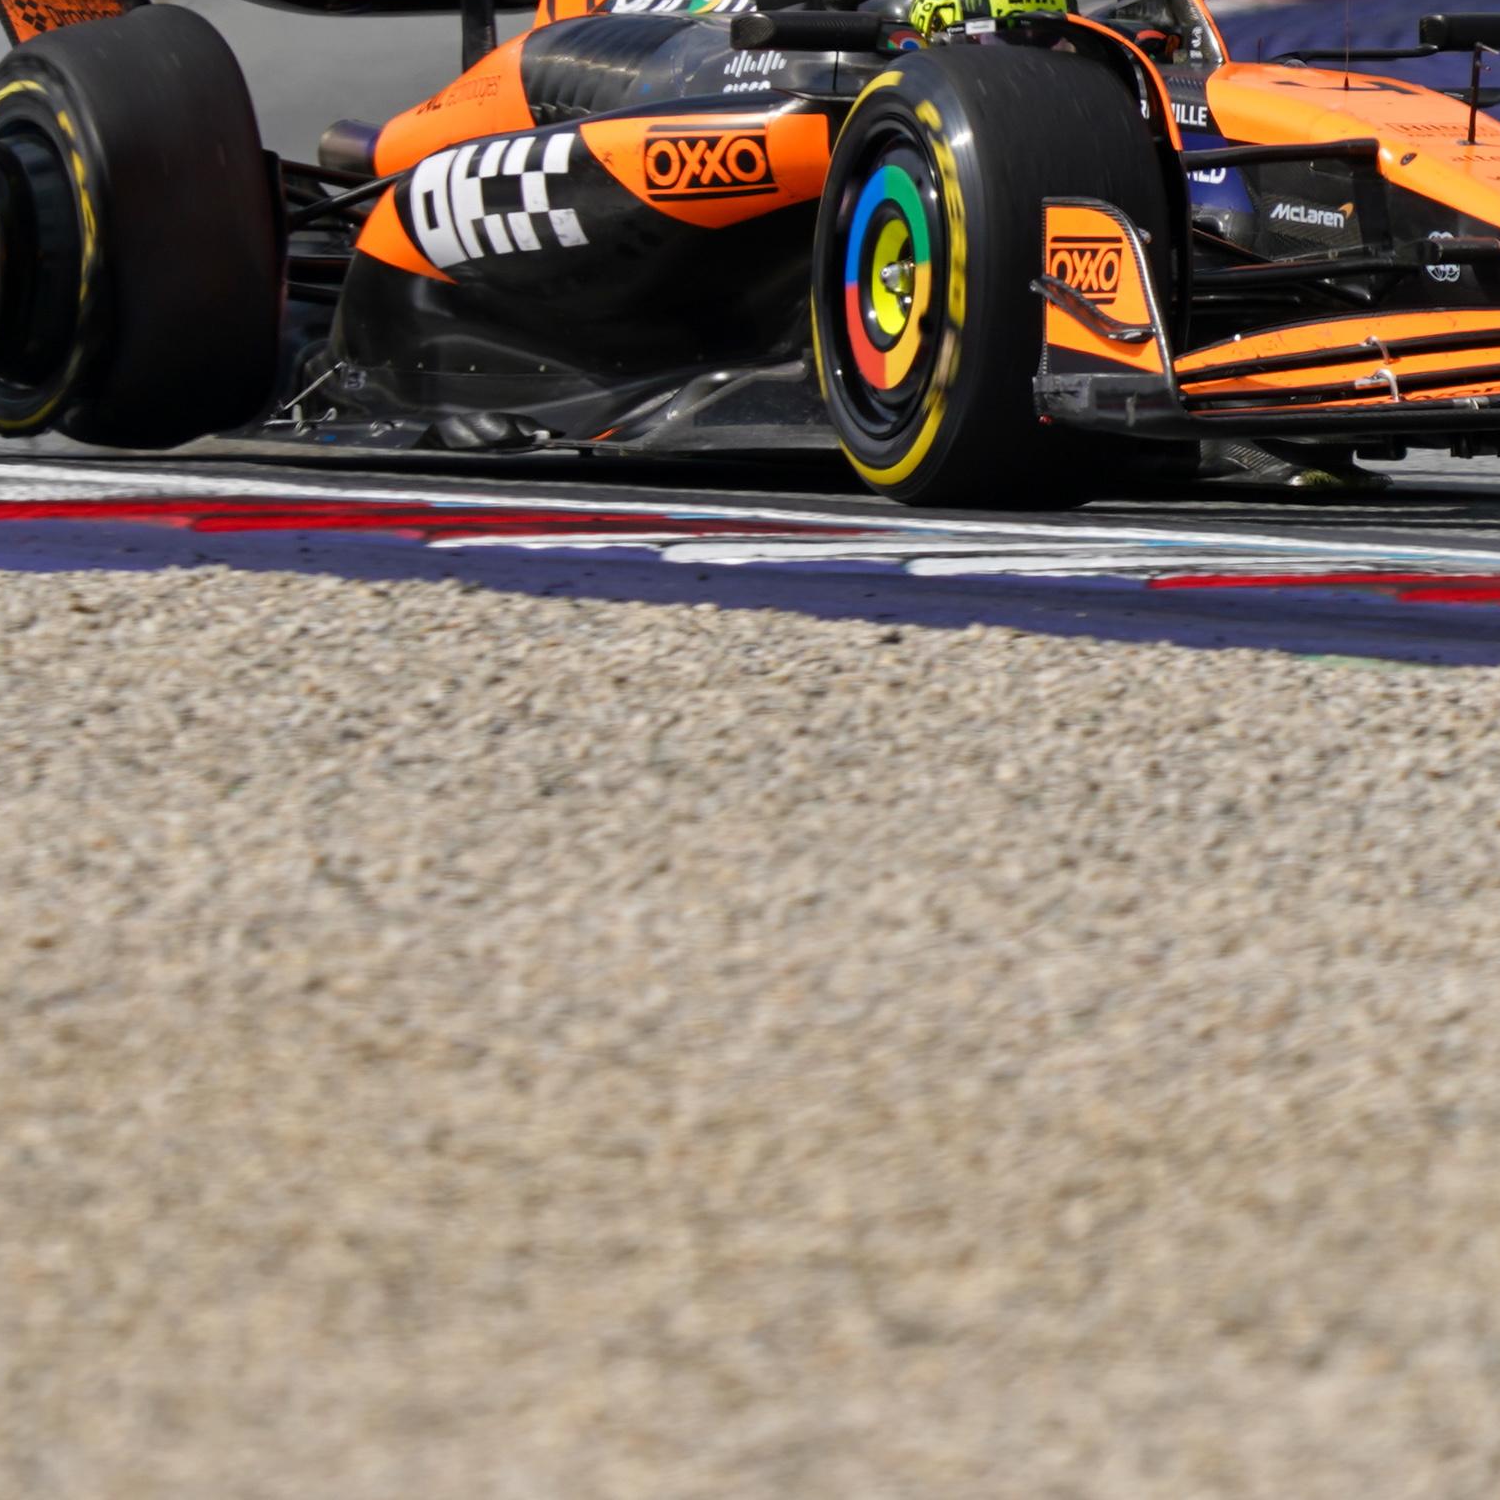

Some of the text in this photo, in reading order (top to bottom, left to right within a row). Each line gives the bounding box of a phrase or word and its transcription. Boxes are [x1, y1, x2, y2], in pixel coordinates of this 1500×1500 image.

[646, 137, 768, 188] OXXO
[1270, 203, 1345, 228] McLaren
[1050, 249, 1121, 291] OXXO
